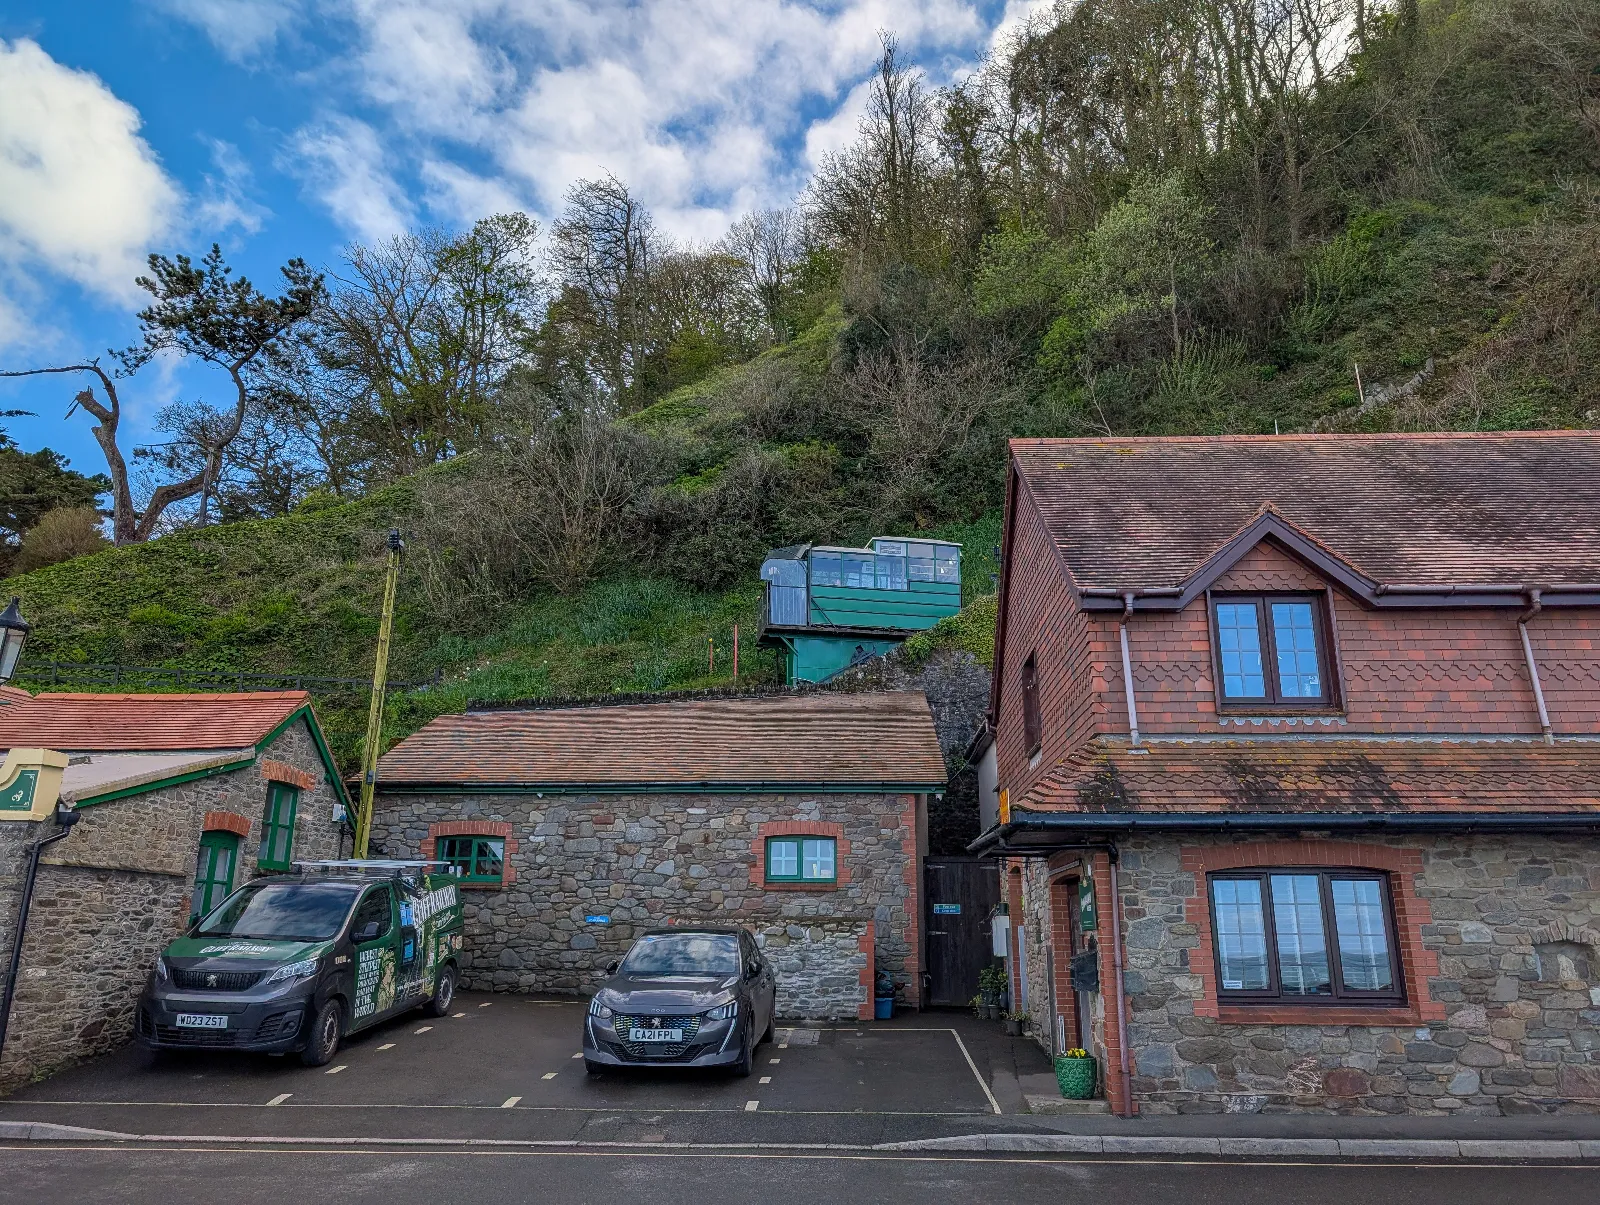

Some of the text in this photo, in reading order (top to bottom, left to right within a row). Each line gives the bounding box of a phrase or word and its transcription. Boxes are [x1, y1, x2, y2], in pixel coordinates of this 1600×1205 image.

[430, 885, 456, 915] RAILWAY
[229, 945, 275, 953] RAILWAY
[180, 1015, 223, 1026] WD23 ZST
[635, 1030, 676, 1040] CA21 FPL
